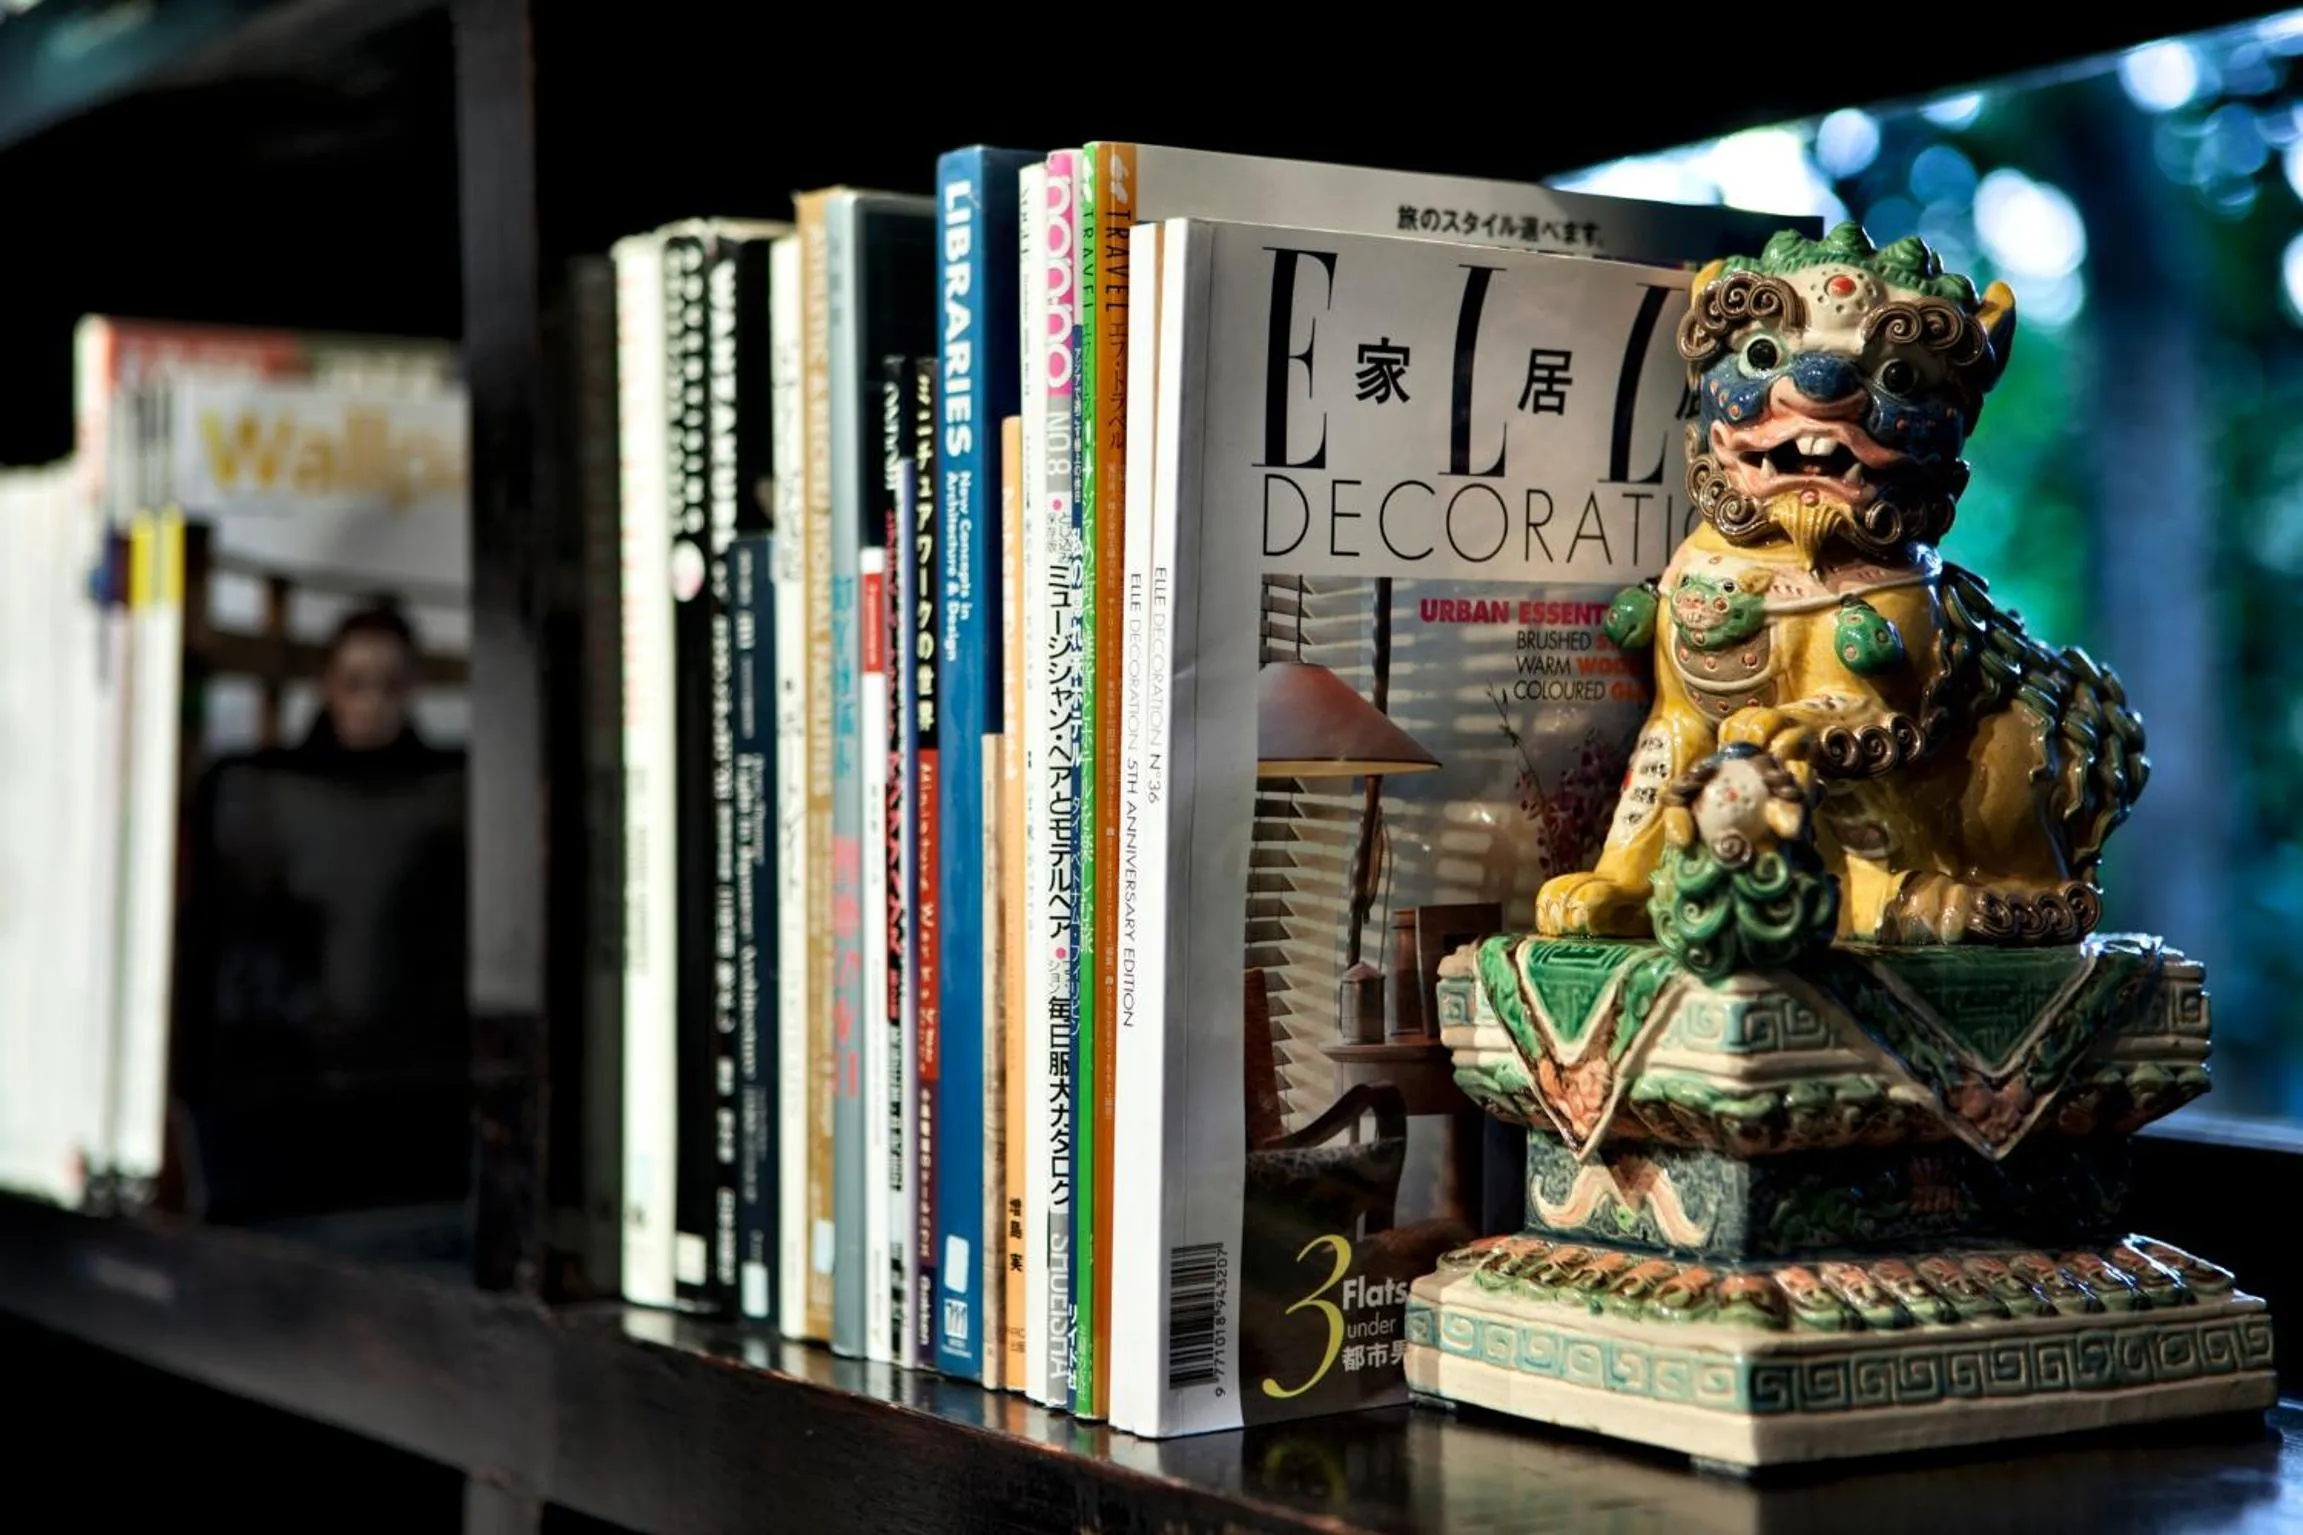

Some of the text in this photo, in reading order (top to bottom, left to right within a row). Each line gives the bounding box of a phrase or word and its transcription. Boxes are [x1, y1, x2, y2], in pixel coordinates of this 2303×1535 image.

[1105, 209, 1130, 313] TRAVEL
[944, 179, 972, 457] LIBRARIES
[1354, 337, 1411, 404] 家
[1517, 347, 1573, 416] 居
[957, 518, 972, 598] Concepts
[1153, 567, 1168, 606] ELLE
[943, 600, 960, 662] Design
[1420, 598, 1510, 624] URBAN
[1516, 630, 1592, 651] BRUSHED
[1149, 613, 1166, 746] DECORATION
[1513, 680, 1605, 700] COLOURED
[1515, 655, 1571, 677] WARM
[1122, 573, 1143, 1028] ELLE DECORATION 5TH ANNIVERSARY EDITION
[1262, 1234, 1352, 1398] 3
[1342, 1275, 1409, 1311] Flats
[1347, 1311, 1397, 1339] under
